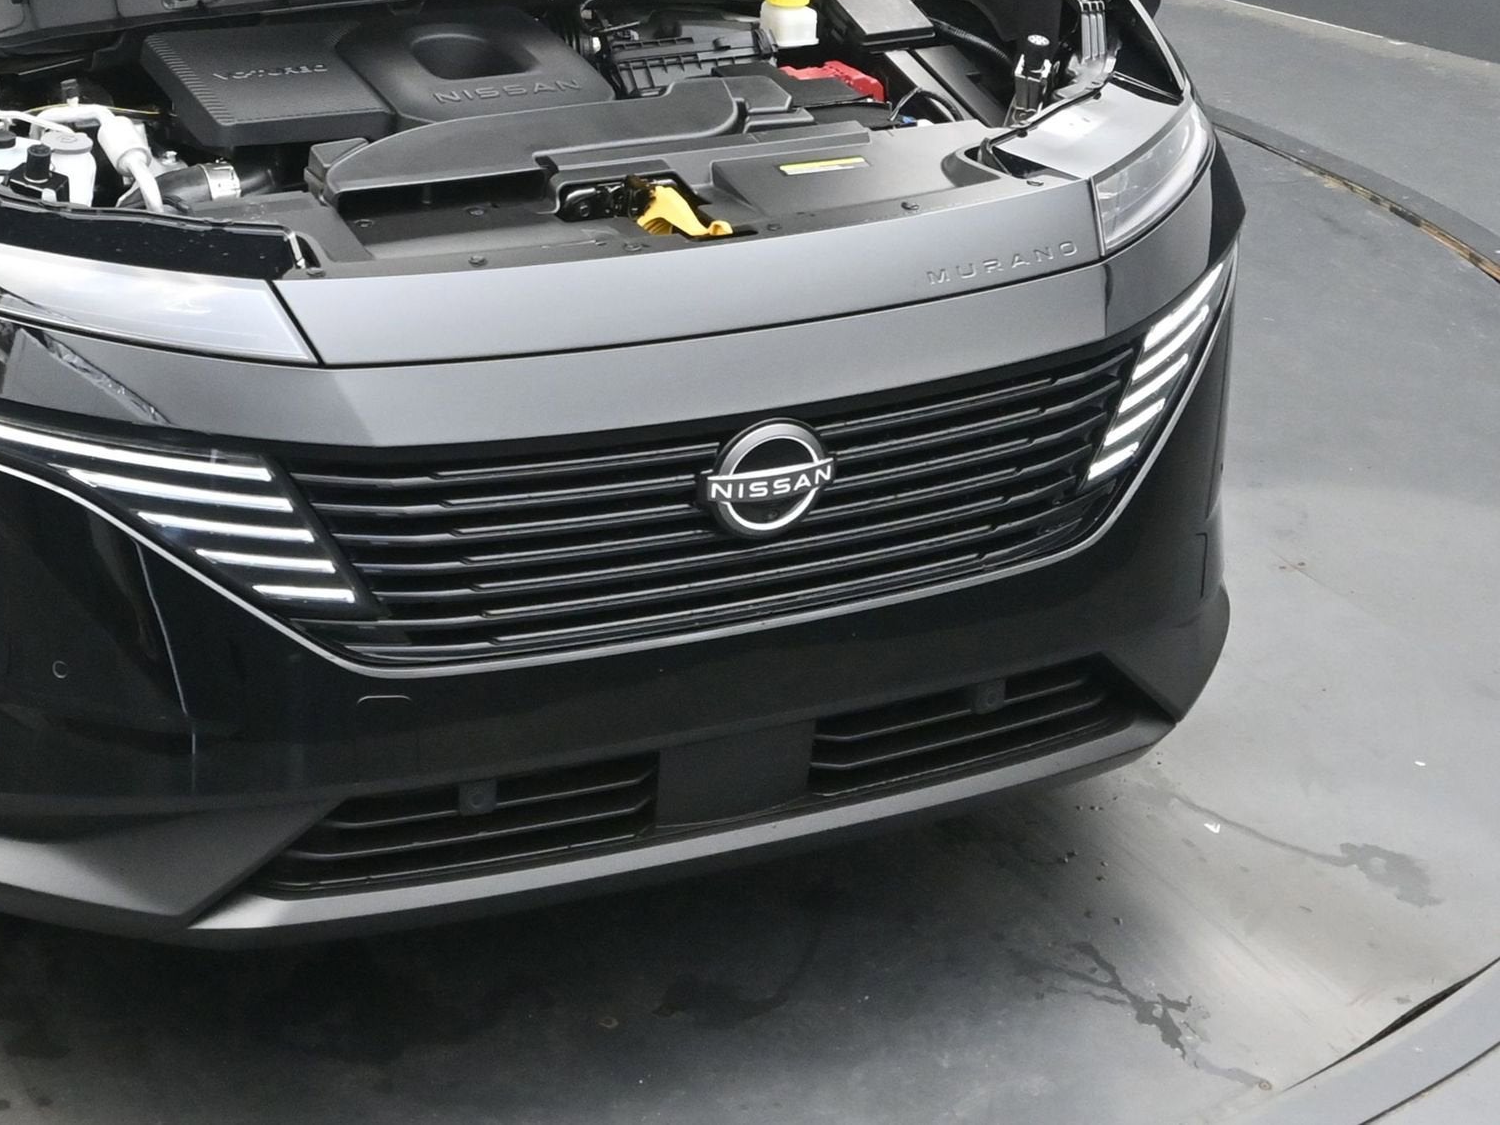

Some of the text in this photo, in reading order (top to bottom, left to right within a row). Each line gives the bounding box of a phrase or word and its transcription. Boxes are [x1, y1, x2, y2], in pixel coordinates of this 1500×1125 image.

[433, 78, 584, 104] NISSAN
[926, 240, 1079, 286] MURANO
[710, 465, 832, 499] NISSAN
